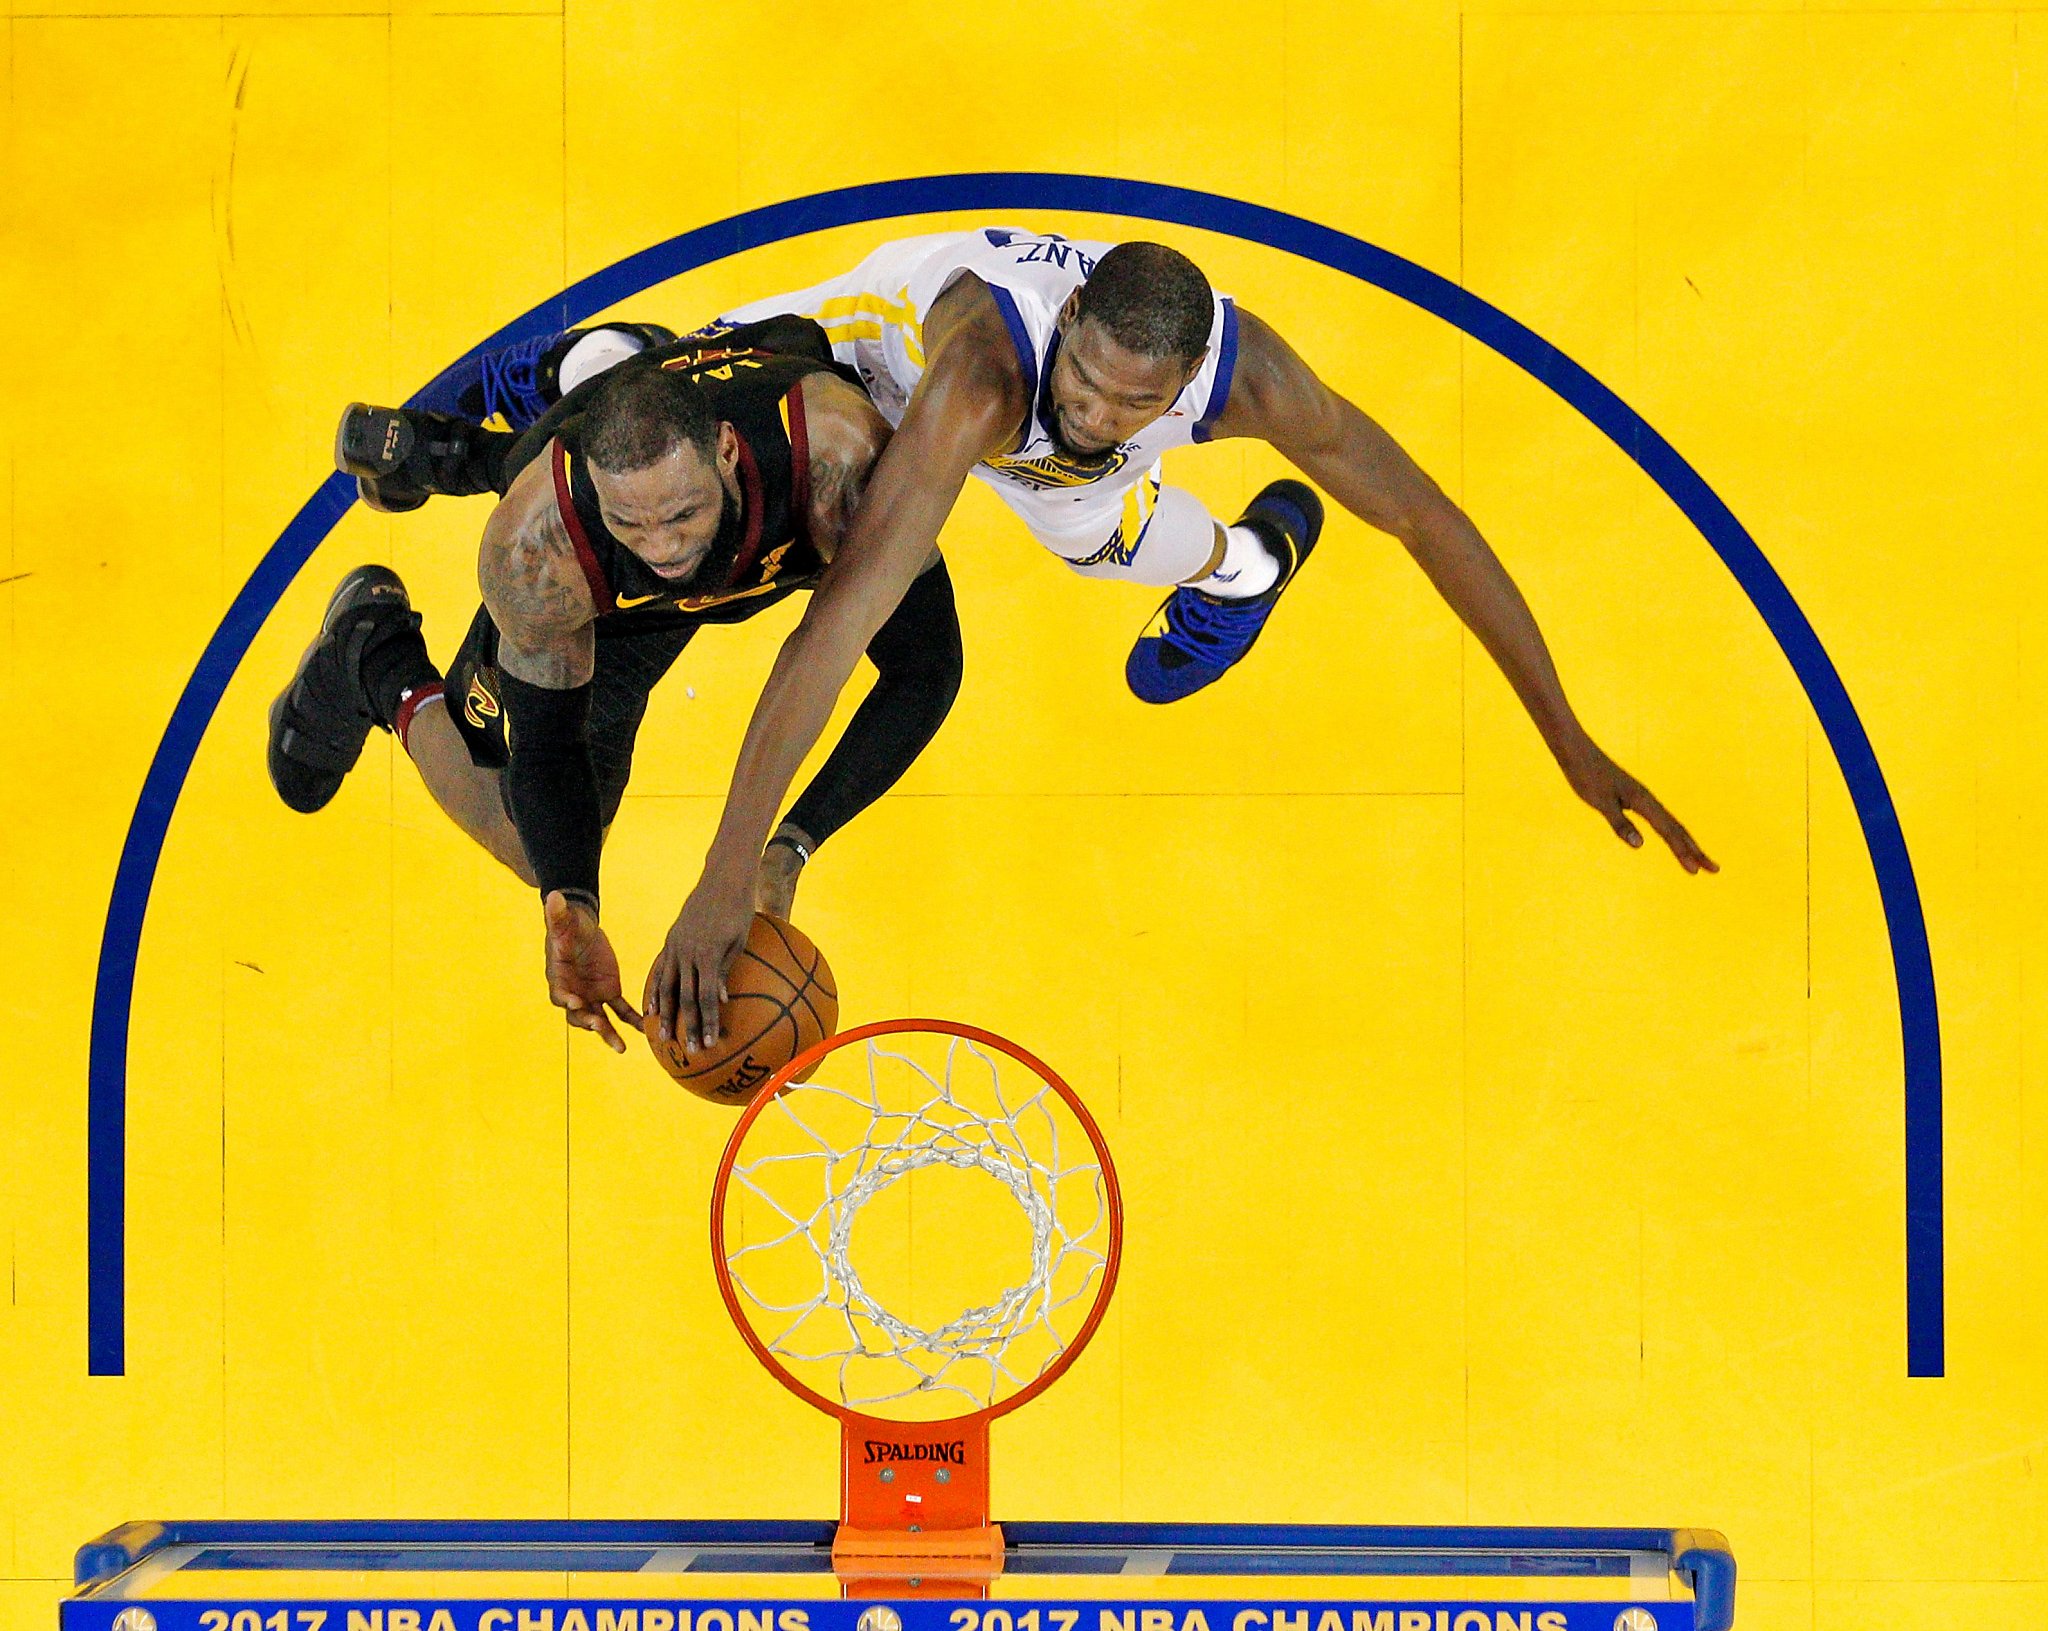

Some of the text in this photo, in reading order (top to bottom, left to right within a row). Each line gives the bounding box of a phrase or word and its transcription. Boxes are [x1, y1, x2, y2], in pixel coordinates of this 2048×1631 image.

[1015, 242, 1096, 280] ANT
[864, 1440, 964, 1465] SPALDING
[199, 1608, 810, 1631] 2017 NBA CHAMPIONS
[949, 1608, 1568, 1631] 2017 NBA CHAMPIONS
